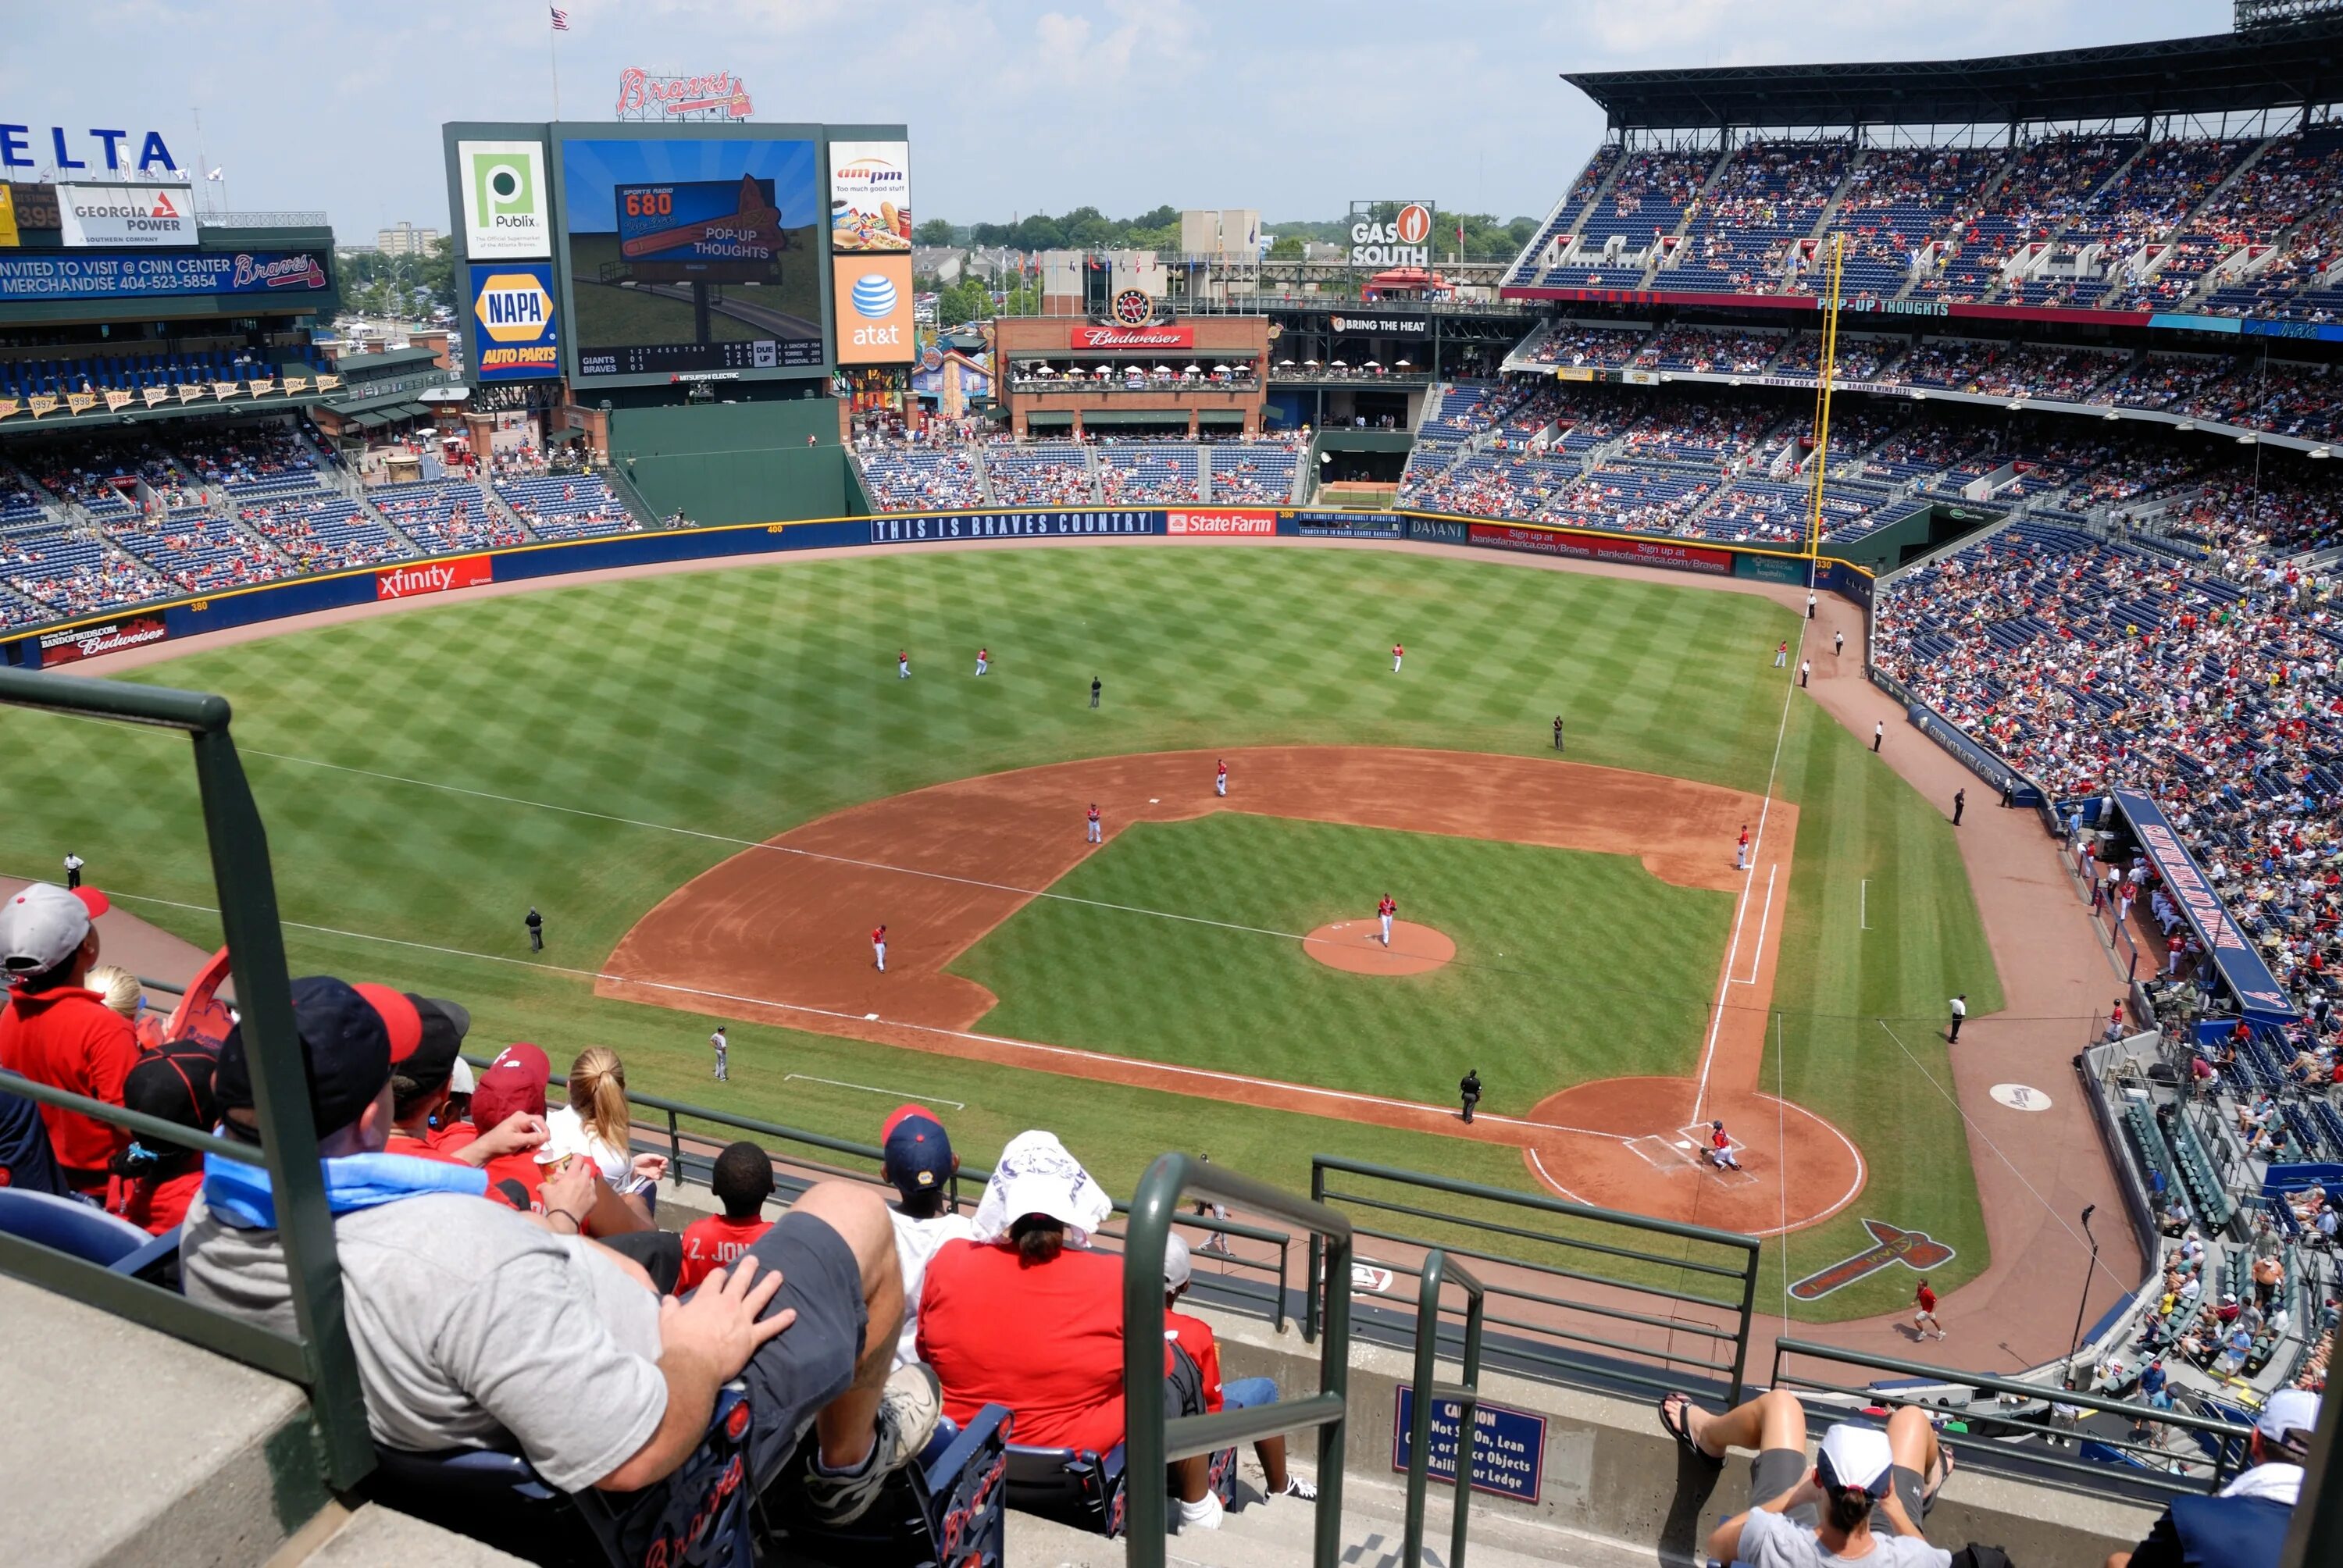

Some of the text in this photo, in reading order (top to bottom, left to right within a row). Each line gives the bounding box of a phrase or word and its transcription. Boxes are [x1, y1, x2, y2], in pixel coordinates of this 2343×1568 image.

[616, 66, 729, 116] Braves
[75, 206, 148, 218] GEORGIA
[626, 193, 672, 216] 680
[18, 205, 61, 226] 395
[496, 215, 536, 227] Publix
[127, 220, 180, 231] POWER
[705, 227, 758, 241] POP-UP
[1351, 223, 1398, 244] GAS
[694, 242, 769, 259] THOUGHTS
[1352, 246, 1428, 267] SOUTH
[58, 261, 79, 276] TO
[82, 261, 118, 275] VISIT
[123, 262, 135, 275] @
[139, 260, 173, 273] CNN
[177, 258, 230, 272] CENTER
[234, 254, 308, 288] Braves
[2, 275, 217, 293] MERCHANDISE 404-523-5854
[488, 293, 542, 323] NAPA
[1881, 301, 1949, 316] THOUGHTS
[853, 324, 900, 344] at&t
[1346, 319, 1426, 332] BRING THE HEAT
[1084, 330, 1182, 346] Budweiser
[482, 347, 557, 365] AUTO PARTS
[582, 356, 615, 365] GIANTS
[583, 365, 617, 373] BRAVES
[217, 385, 234, 394] 2002
[252, 383, 269, 391] 2003
[286, 380, 301, 390] 2004
[319, 379, 334, 387] 2005
[1847, 383, 1874, 391] BRAVES
[71, 396, 90, 407] 1998
[108, 394, 127, 404] 1999
[147, 391, 162, 401] 2000
[181, 388, 197, 397] 2001
[33, 400, 51, 410] 1997
[877, 513, 1147, 540] THIS IS BRAVES COUNTRY
[1412, 520, 1462, 538] DASANI
[1509, 529, 1528, 540] Sign
[1531, 533, 1542, 541] up
[1471, 533, 1590, 556] bankofamerica.com/Braves
[1638, 543, 1685, 557] Sign up at
[1597, 548, 1724, 571] bankofamerica.com/Braves
[1816, 560, 1832, 569] 330
[380, 565, 455, 597] xfinity
[191, 602, 208, 612] 380
[41, 625, 117, 648] BANDOFBUDS.COM
[78, 628, 165, 655] Budweiser
[1929, 725, 1949, 743] GOLDEN
[1946, 739, 1963, 757] MOON
[1961, 748, 1976, 768] HOTEL
[1979, 764, 2000, 785] CASINO
[2138, 824, 2246, 950] HOME OF THE BRAVES
[690, 1238, 705, 1260] Z.
[1444, 1403, 1496, 1427] CAION
[1431, 1420, 1452, 1438] Not
[1438, 1443, 1450, 1453] or
[1474, 1430, 1494, 1448] On,
[1497, 1434, 1525, 1453] Lean
[1487, 1451, 1531, 1473] Objects
[1428, 1456, 1522, 1489] Raili or Ledge
